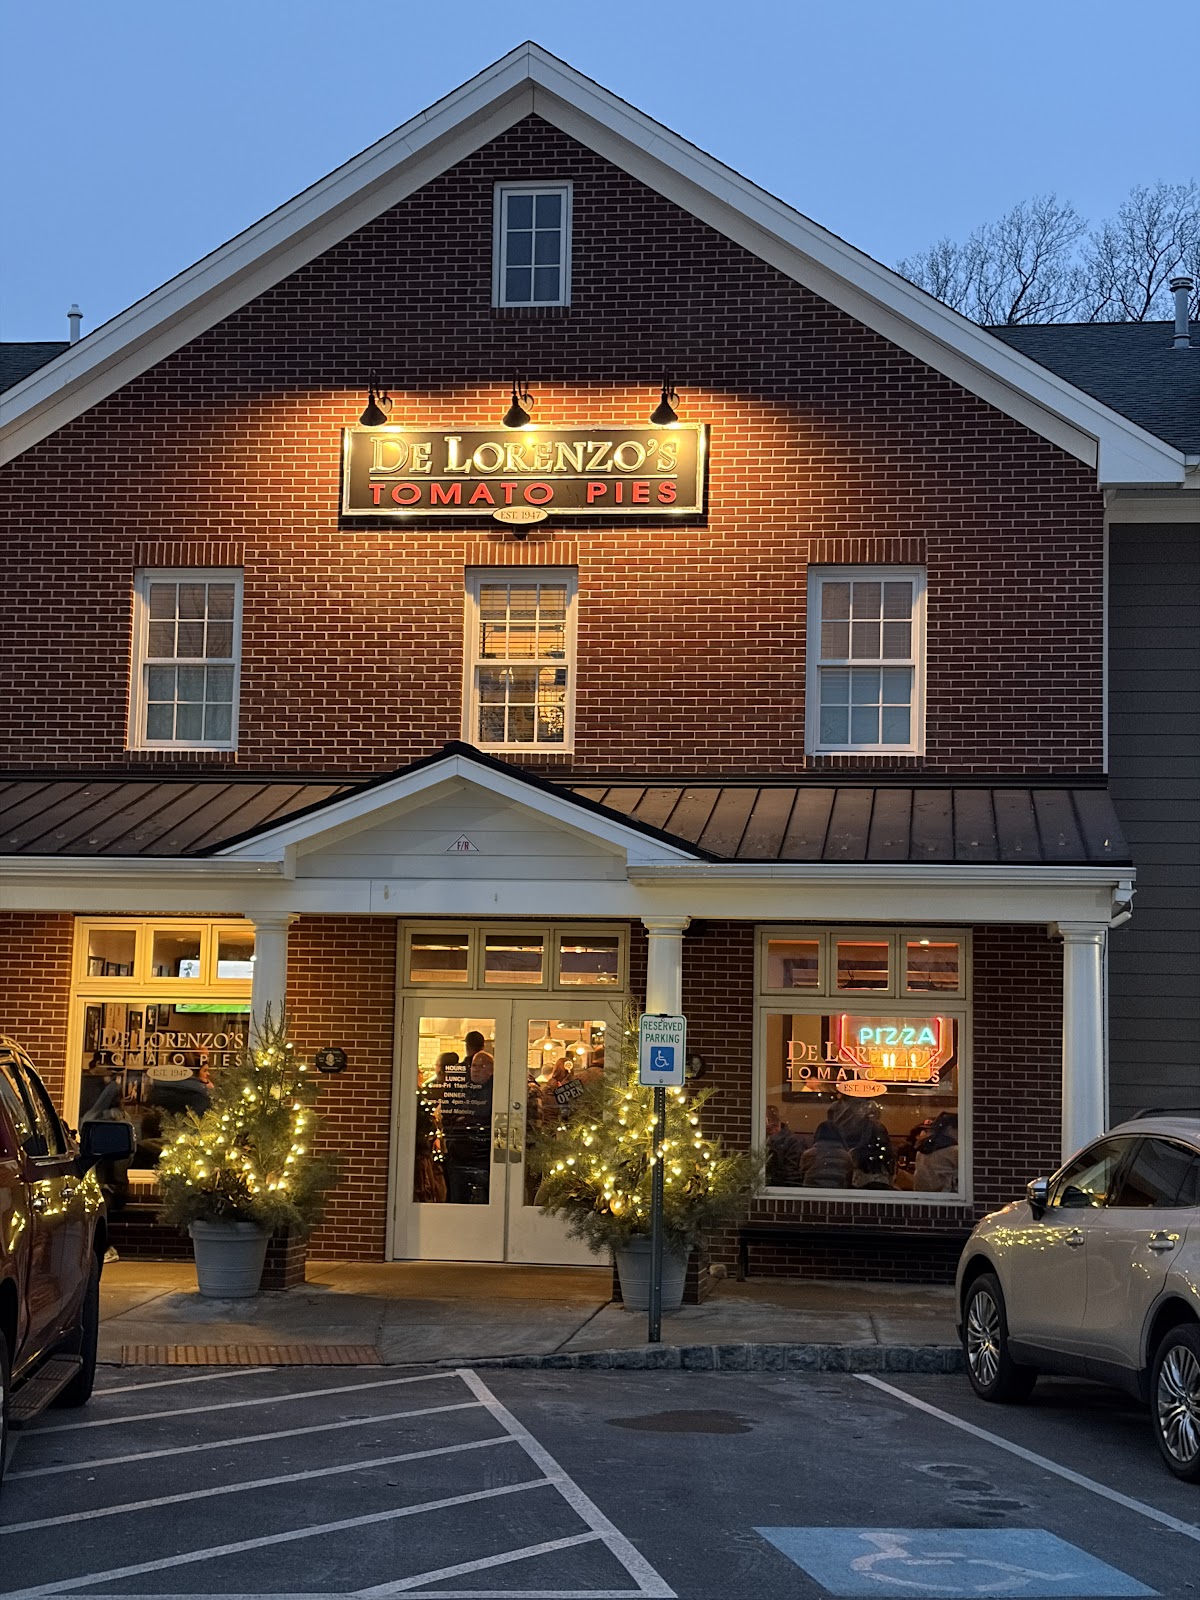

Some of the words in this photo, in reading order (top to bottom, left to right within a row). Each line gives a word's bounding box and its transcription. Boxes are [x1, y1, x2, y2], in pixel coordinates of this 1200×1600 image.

[444, 436, 678, 474] LORENZO'S
[369, 482, 554, 504] TOMATO
[587, 481, 677, 504] PIES
[500, 511, 518, 519] EST.
[522, 511, 541, 519] 1947
[457, 841, 470, 850] F/R
[643, 1021, 683, 1031] RESERVED
[645, 1034, 680, 1043] PARKING
[859, 1027, 937, 1045] PIZZA
[100, 1053, 185, 1065] TOMATO
[201, 1054, 243, 1067] PIES
[787, 1066, 876, 1080] TOMATO
[557, 1085, 585, 1104] OPEN
